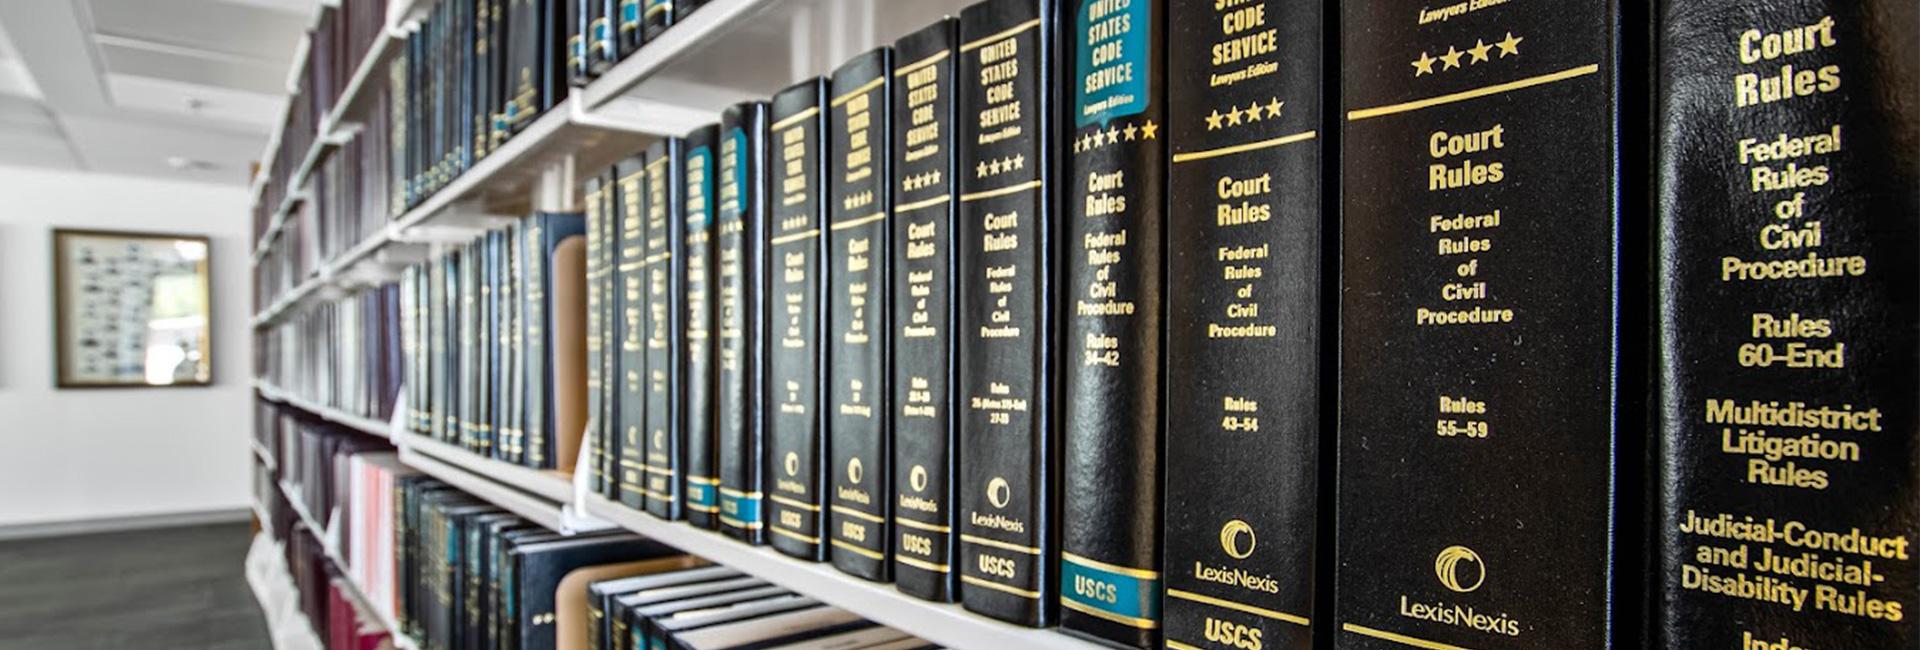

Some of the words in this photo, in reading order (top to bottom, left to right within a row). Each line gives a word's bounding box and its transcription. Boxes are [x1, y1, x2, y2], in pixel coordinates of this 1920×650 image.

[1088, 13, 1131, 46] STATES
[1223, 3, 1265, 35] CODE
[980, 37, 1017, 65] UNITED
[1092, 39, 1124, 67] CODE
[1212, 28, 1278, 66] SERVICE
[1739, 15, 1837, 65] Court
[981, 58, 1019, 86] STATES
[1085, 62, 1133, 94] SERVICE
[1247, 61, 1279, 78] Edition
[987, 81, 1014, 104] CODE
[1735, 64, 1841, 108] Rules
[979, 101, 1021, 128] SERVICE
[1429, 123, 1505, 159] Court
[1739, 124, 1841, 165] Federal
[1088, 169, 1124, 193] Court
[1217, 172, 1271, 199] Court
[1429, 160, 1504, 192] Rules
[1752, 163, 1830, 192] Rules
[1085, 192, 1126, 217] Rules
[1217, 202, 1271, 226] Rules
[1775, 191, 1805, 220] of
[984, 210, 1018, 231] Court
[1430, 209, 1500, 233] Federal
[983, 232, 1018, 252] Rules
[1084, 229, 1126, 249] Federal
[1438, 236, 1491, 256] Rules
[1760, 221, 1822, 250] Civil
[1088, 249, 1121, 266] Rules
[1218, 243, 1269, 262] Federal
[1096, 265, 1110, 281] of
[1224, 265, 1262, 280] Rules
[1457, 259, 1478, 277] of
[1722, 252, 1867, 282] Procedure
[1090, 281, 1117, 299] Civil
[1237, 284, 1253, 298] of
[1441, 282, 1487, 302] Civil
[1077, 299, 1135, 316] Procedure
[1227, 303, 1258, 319] Civil
[1417, 307, 1514, 326] Procedure
[1208, 323, 1277, 338] Procedure
[1752, 312, 1832, 339] Rules
[1086, 333, 1118, 349] Rules
[1224, 396, 1258, 412] Rules
[1439, 395, 1486, 414] Rules
[1705, 398, 1882, 432] Multidistrict
[1722, 428, 1860, 462] Litigation
[1747, 458, 1829, 490] Rules
[971, 511, 1024, 533] LexisNexis
[1679, 509, 1910, 561] Judicial-Conduct
[903, 533, 932, 556] USCS
[979, 553, 1015, 579] USCS
[1195, 561, 1280, 594] LexisNexis
[1696, 543, 1748, 570] and
[1753, 547, 1885, 587] Judicial-
[1074, 574, 1117, 605] USCS
[1681, 563, 1808, 612] Disability
[1815, 584, 1903, 622] Rules
[1400, 594, 1520, 637] LexisNexis
[1204, 617, 1263, 650] USCS
